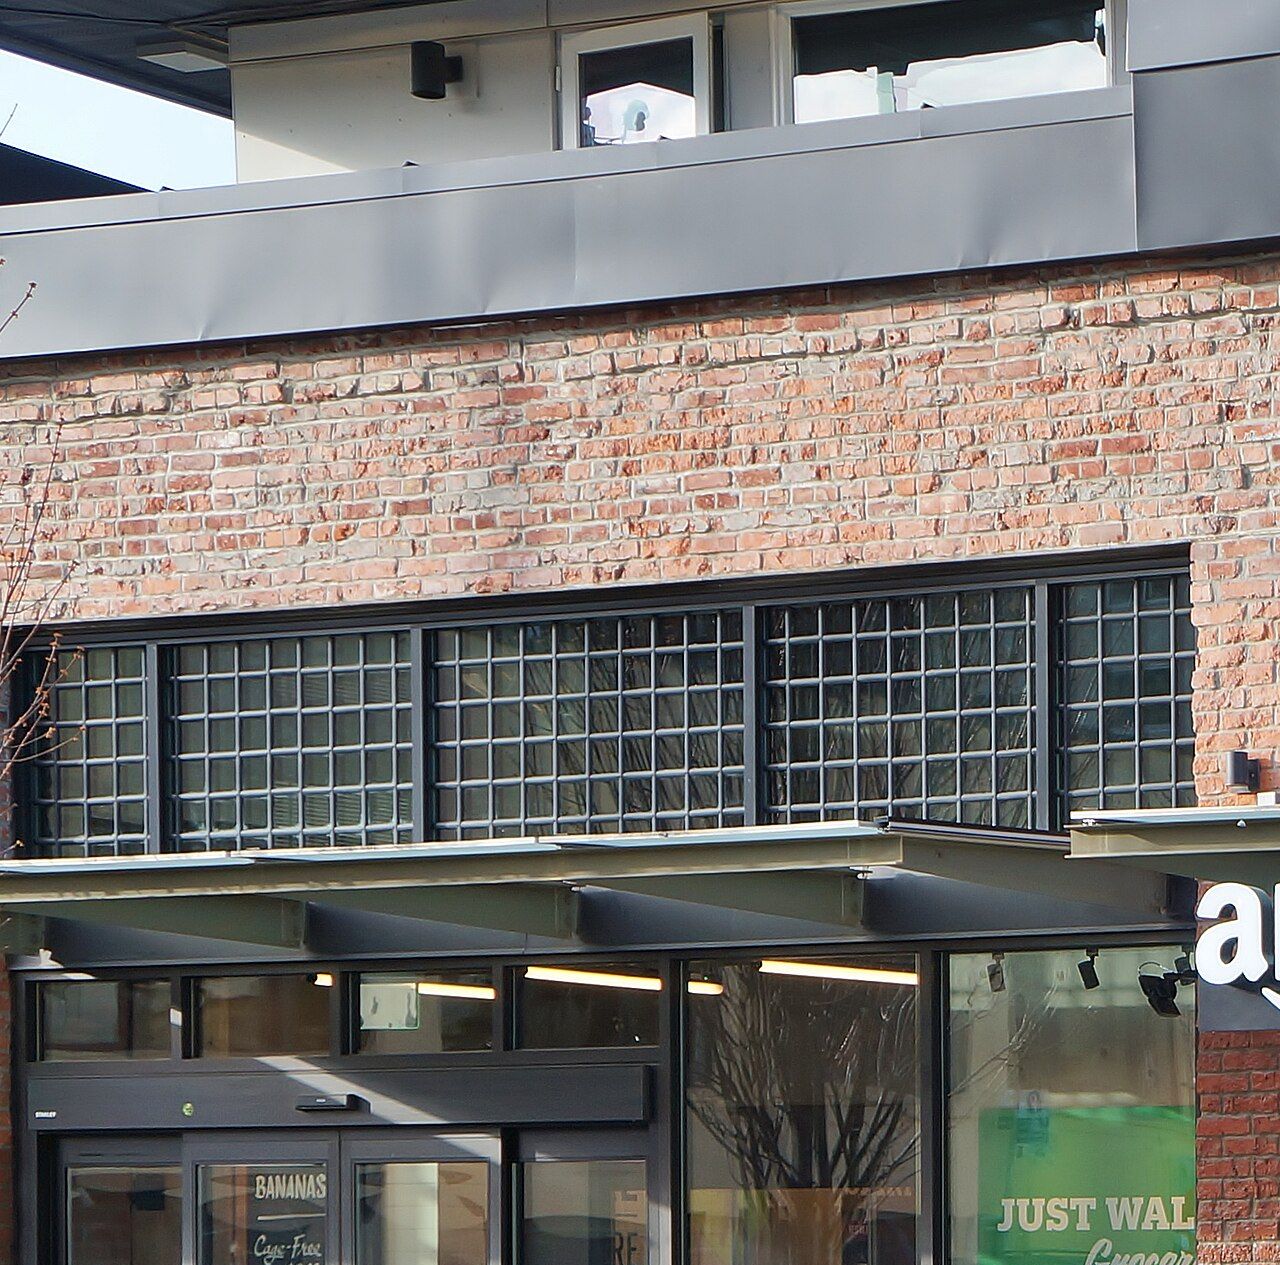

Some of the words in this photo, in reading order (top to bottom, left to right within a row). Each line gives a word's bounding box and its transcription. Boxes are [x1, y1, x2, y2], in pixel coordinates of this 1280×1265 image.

[255, 1173, 327, 1199] BANANAS
[997, 1197, 1097, 1232] JUST
[254, 1234, 322, 1265] Cage-Free
